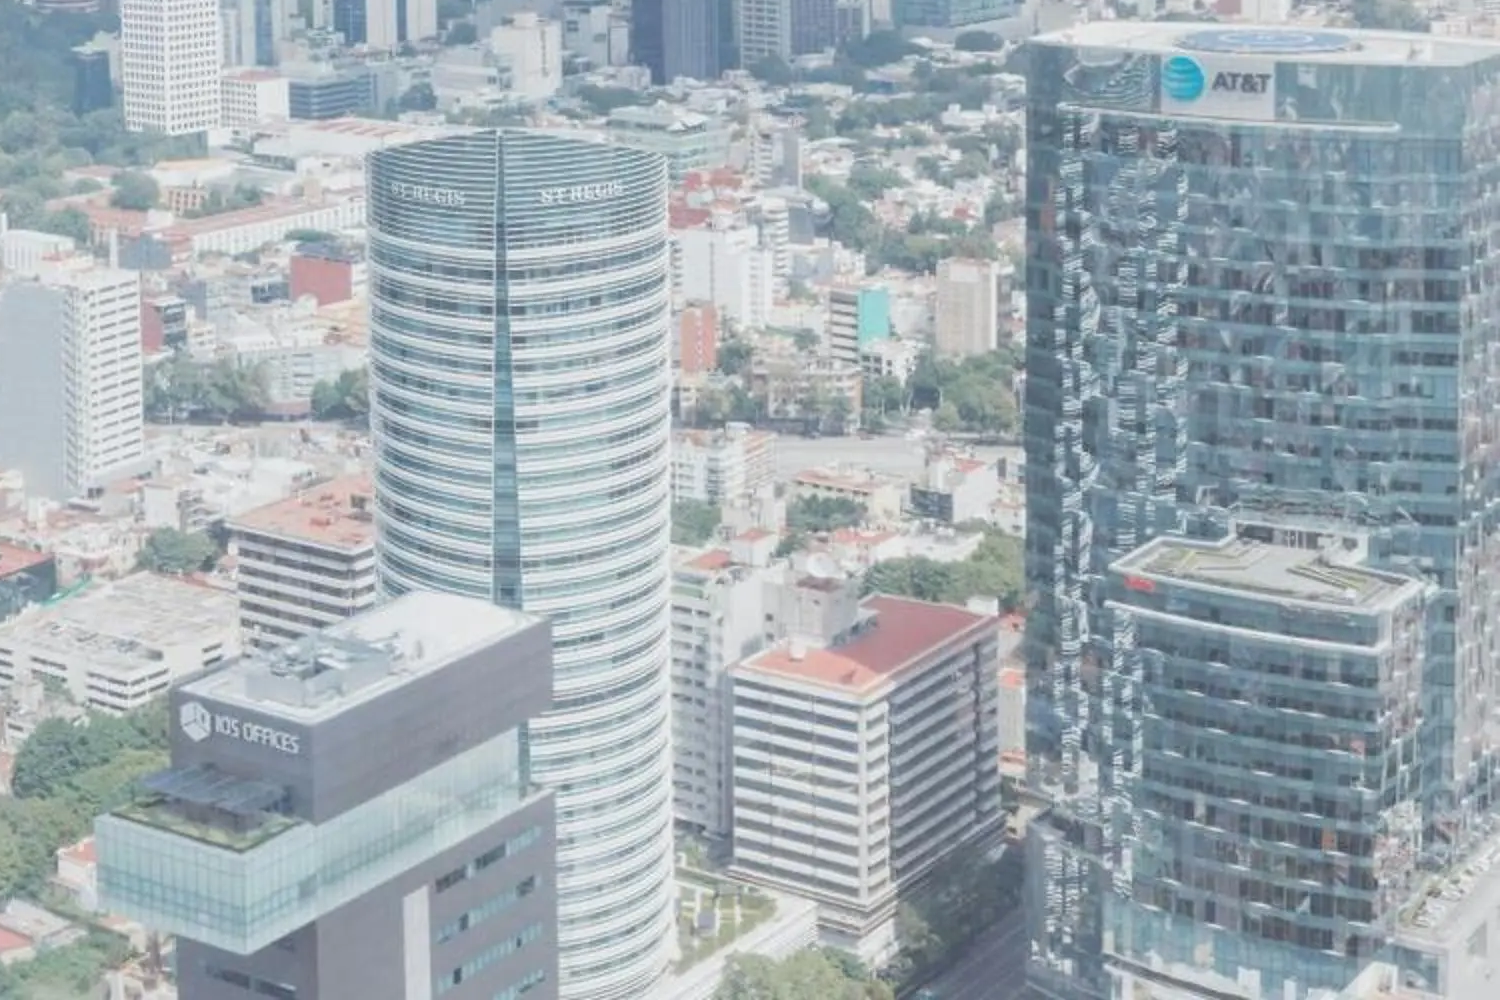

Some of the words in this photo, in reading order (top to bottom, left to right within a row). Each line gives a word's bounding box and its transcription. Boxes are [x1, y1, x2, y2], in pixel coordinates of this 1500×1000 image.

[1212, 71, 1273, 93] AT&T
[215, 714, 240, 738] IOS
[243, 722, 300, 755] OFFICES
